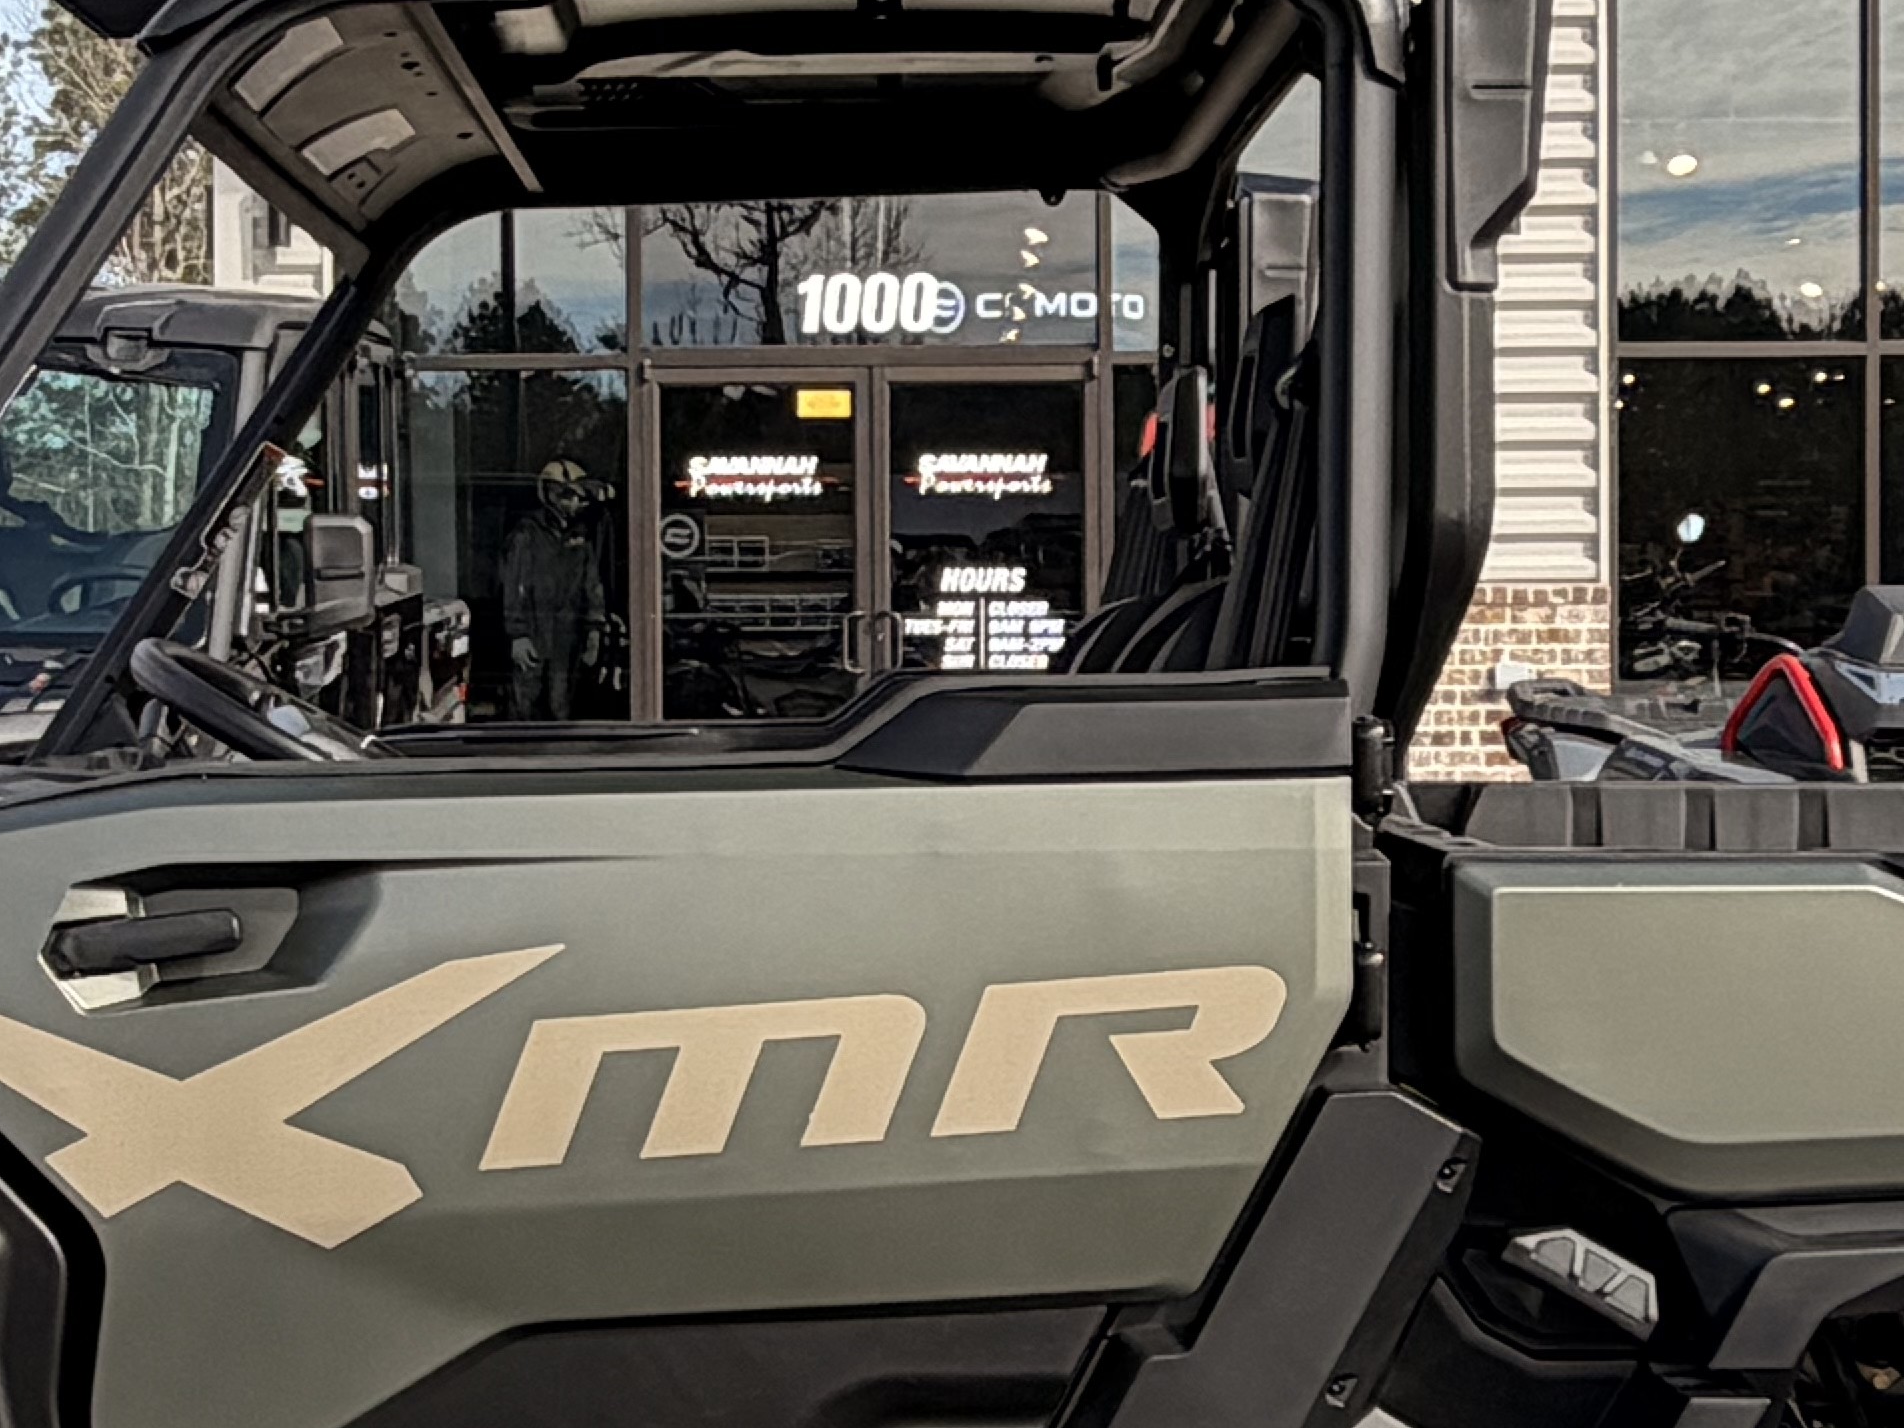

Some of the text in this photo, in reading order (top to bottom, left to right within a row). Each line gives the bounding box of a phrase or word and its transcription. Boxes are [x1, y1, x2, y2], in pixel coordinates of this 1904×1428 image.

[797, 272, 939, 334] 1000
[976, 291, 1144, 319] CMOO
[918, 454, 1048, 474] SAVANNAH
[940, 567, 1027, 593] HOURS
